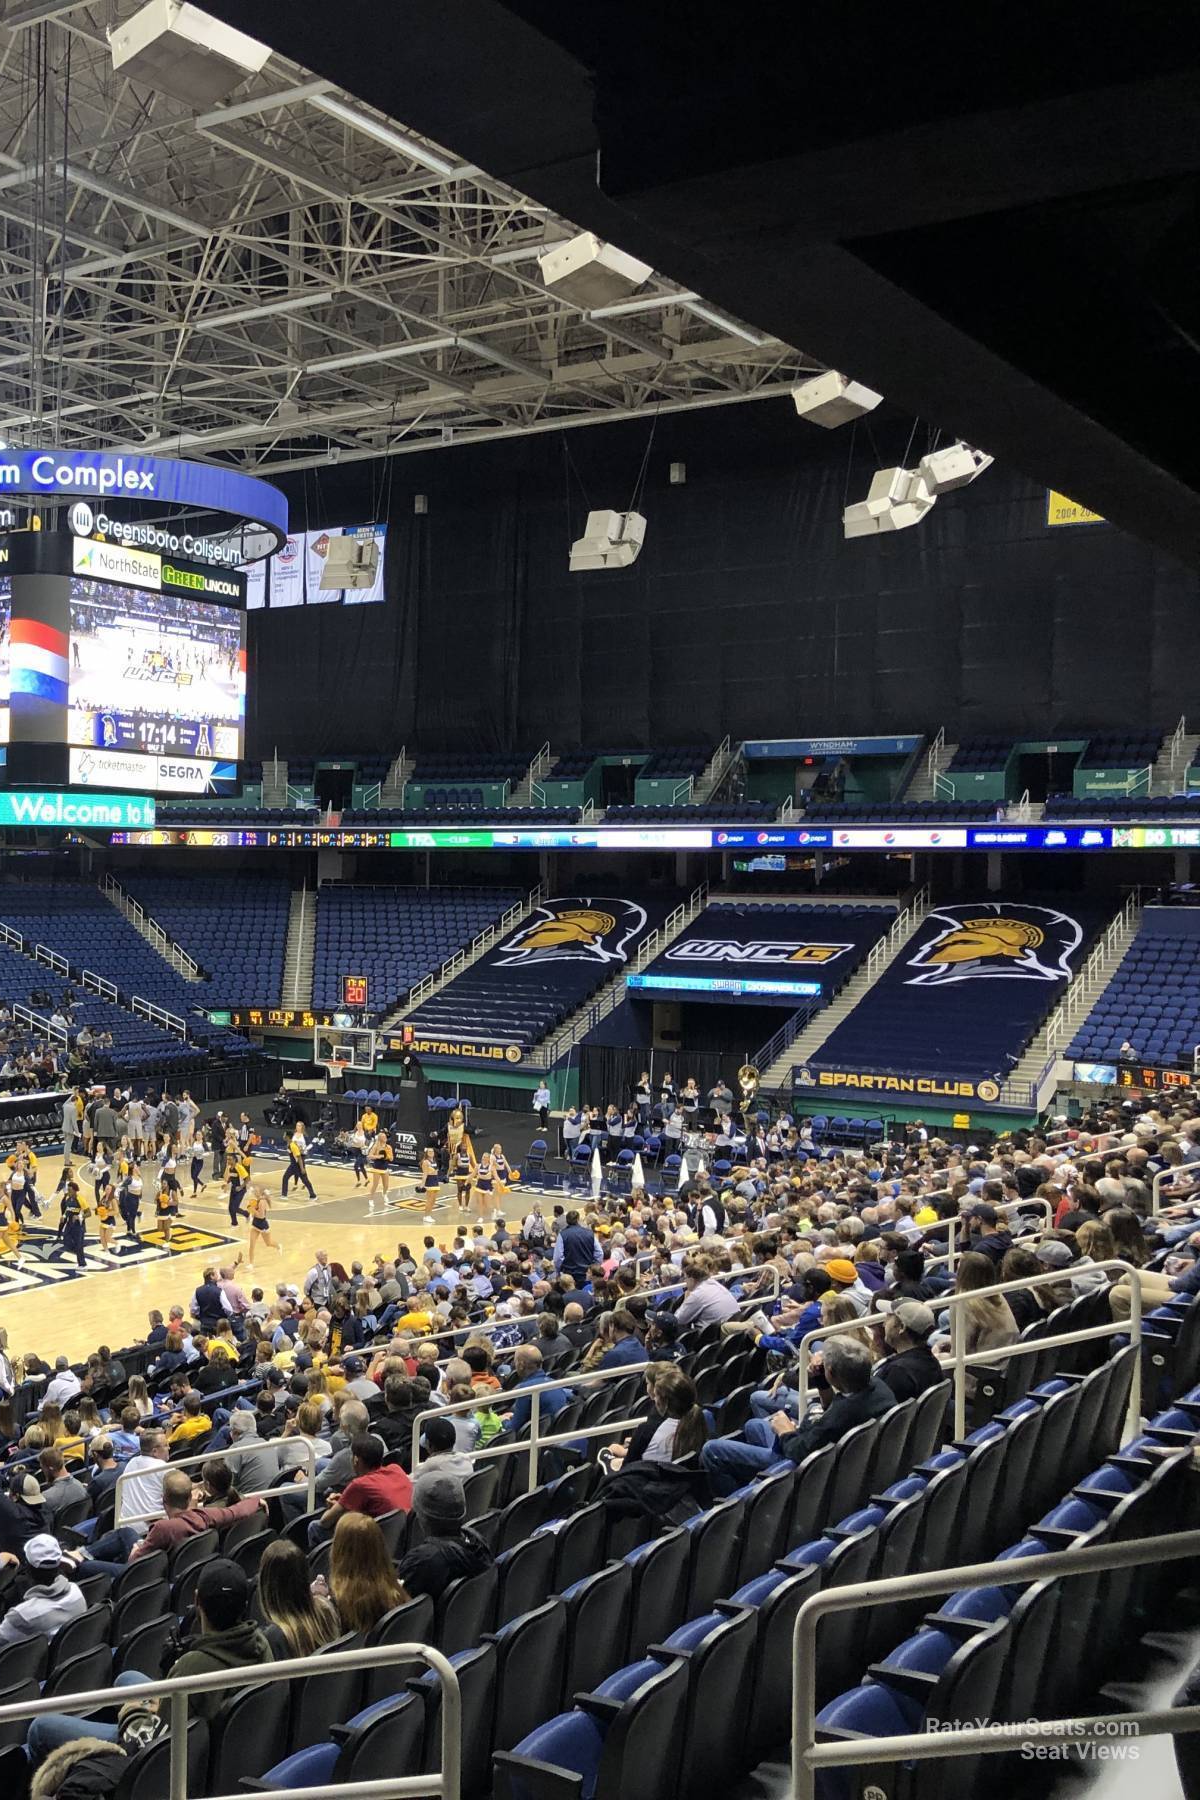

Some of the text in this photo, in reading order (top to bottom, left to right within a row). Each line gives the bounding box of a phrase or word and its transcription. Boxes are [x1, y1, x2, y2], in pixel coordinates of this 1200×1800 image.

[31, 456, 154, 493] Complex
[1056, 508, 1077, 519] 2004
[96, 514, 179, 551] Greensboro
[182, 535, 242, 564] Coliseum
[99, 553, 159, 579] NorthState
[161, 565, 239, 597] GREEN LINCOLN
[139, 722, 176, 745] 17:14
[810, 741, 853, 749] WYNDHAM
[98, 759, 147, 773] ticketmaster
[160, 764, 204, 780] SEGRA
[11, 793, 121, 822] Welcome
[127, 803, 141, 824] to
[138, 833, 152, 844] 41
[212, 834, 228, 846] 28
[271, 835, 277, 843] 0
[297, 835, 301, 843] 1
[320, 835, 329, 843] 10
[344, 835, 354, 843] 20
[368, 835, 377, 843] 21
[405, 833, 437, 847] TFA
[1145, 830, 1166, 844] DO
[1170, 830, 1199, 844] THE
[672, 941, 845, 962] UNCG
[348, 979, 366, 987] 17:14
[348, 988, 364, 1002] 20
[251, 1016, 262, 1024] 41
[270, 1011, 292, 1020] 17:14
[303, 1017, 314, 1026] 28
[390, 1038, 504, 1058] SARTAN CLUB
[819, 1072, 914, 1092] SPARTAN
[917, 1079, 974, 1097] CLUB
[1123, 1072, 1132, 1085] 3
[1144, 1077, 1156, 1087] 41
[396, 1133, 417, 1144] TFA
